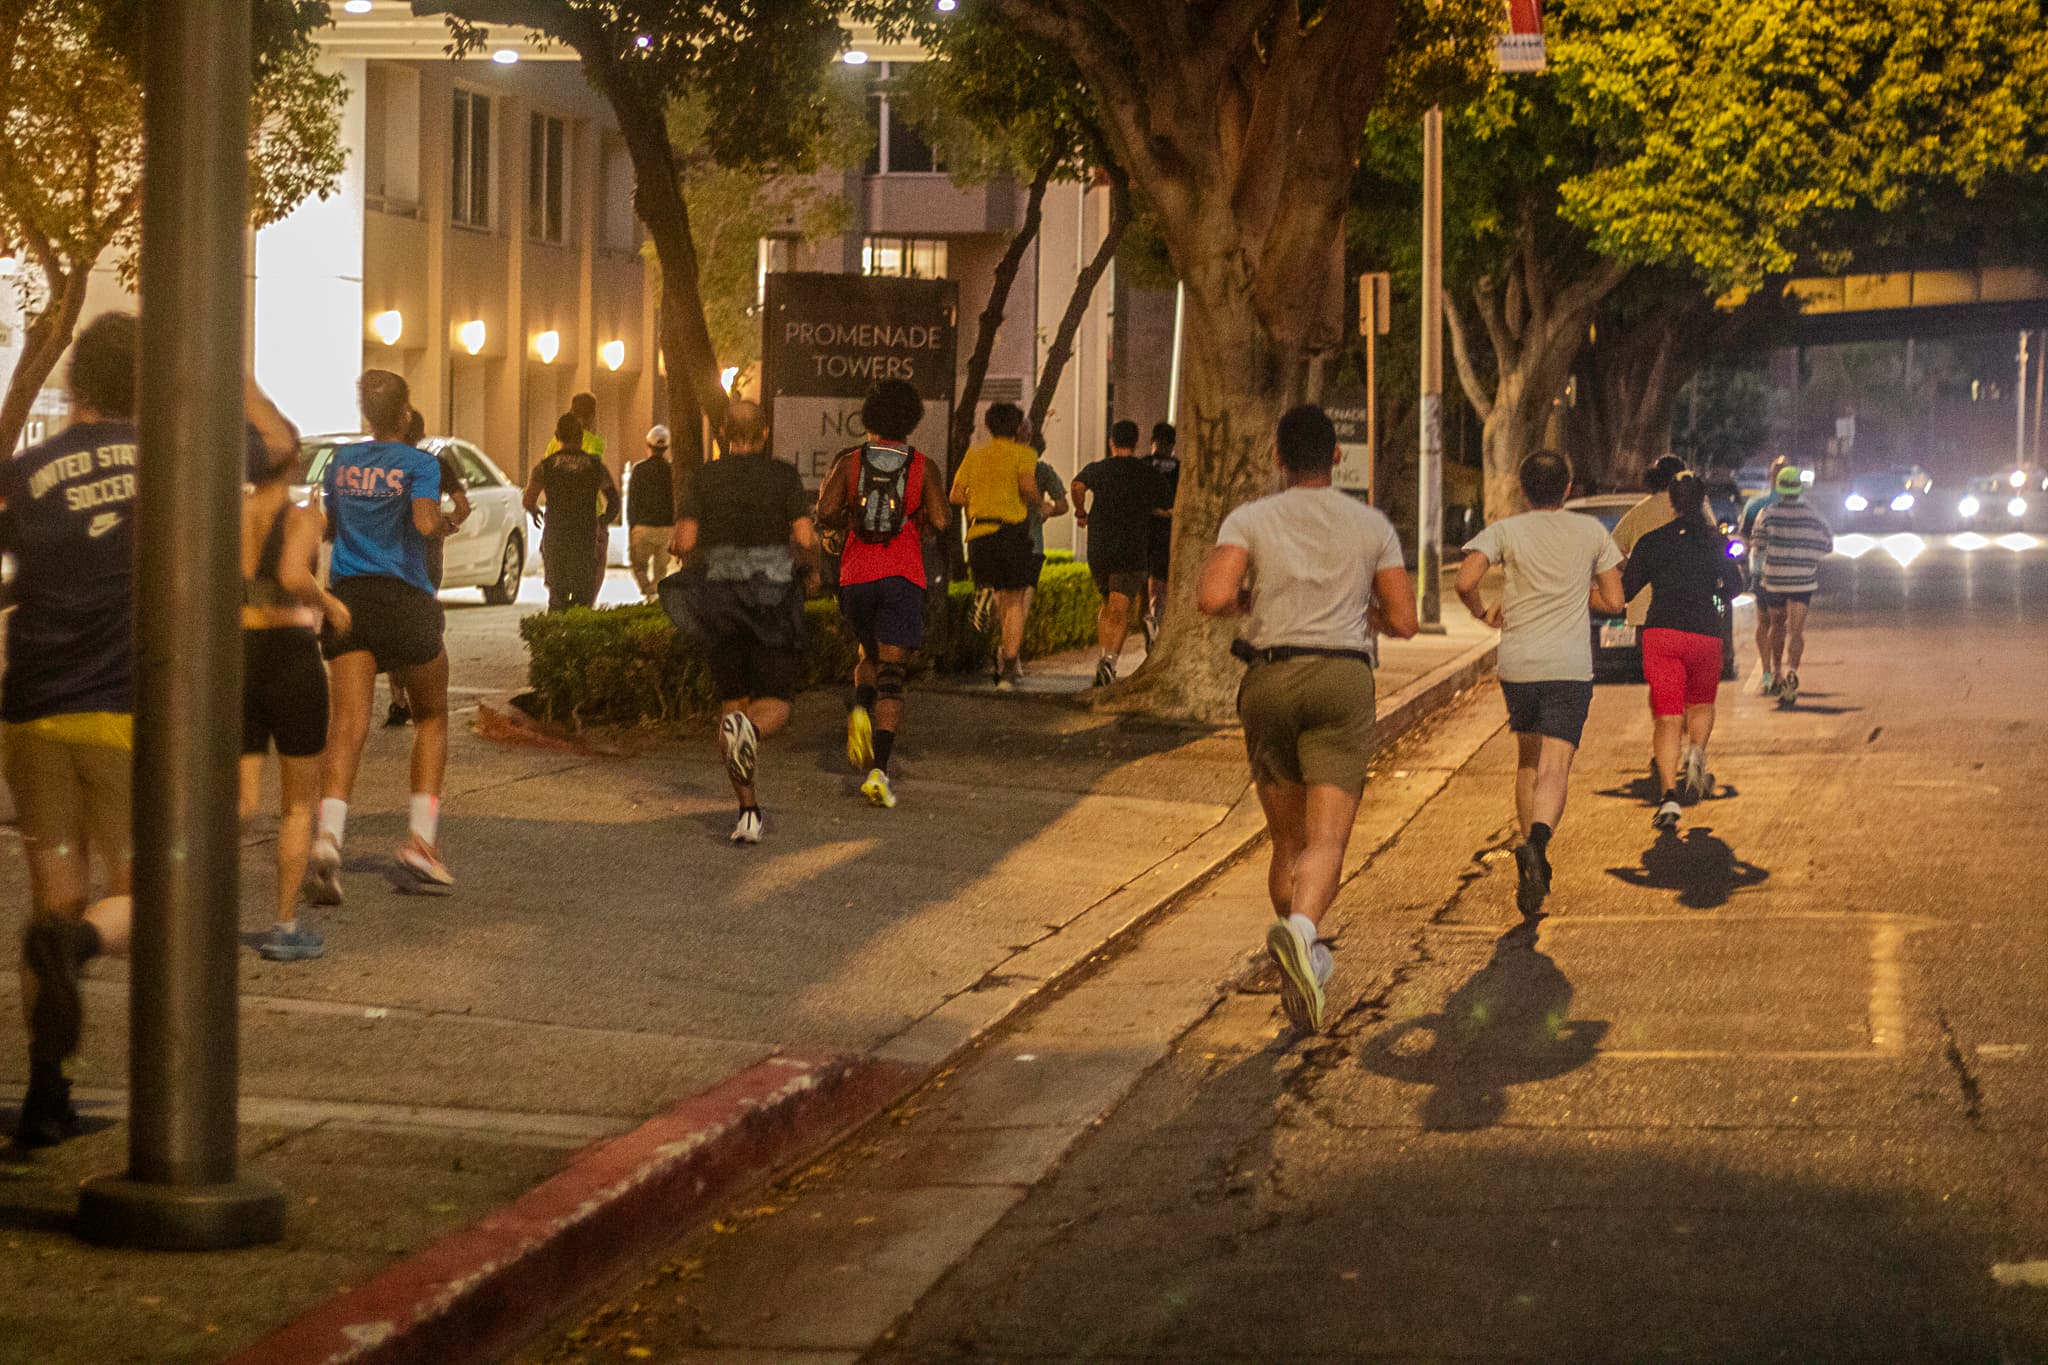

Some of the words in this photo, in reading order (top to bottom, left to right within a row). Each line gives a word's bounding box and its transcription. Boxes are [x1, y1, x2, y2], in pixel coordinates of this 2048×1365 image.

[785, 322, 943, 349] PROMENADE
[812, 354, 915, 380] TOWERS
[821, 411, 866, 437] NO
[29, 451, 91, 499] UNITED
[97, 444, 137, 468] STA
[66, 473, 136, 511] SOCCER
